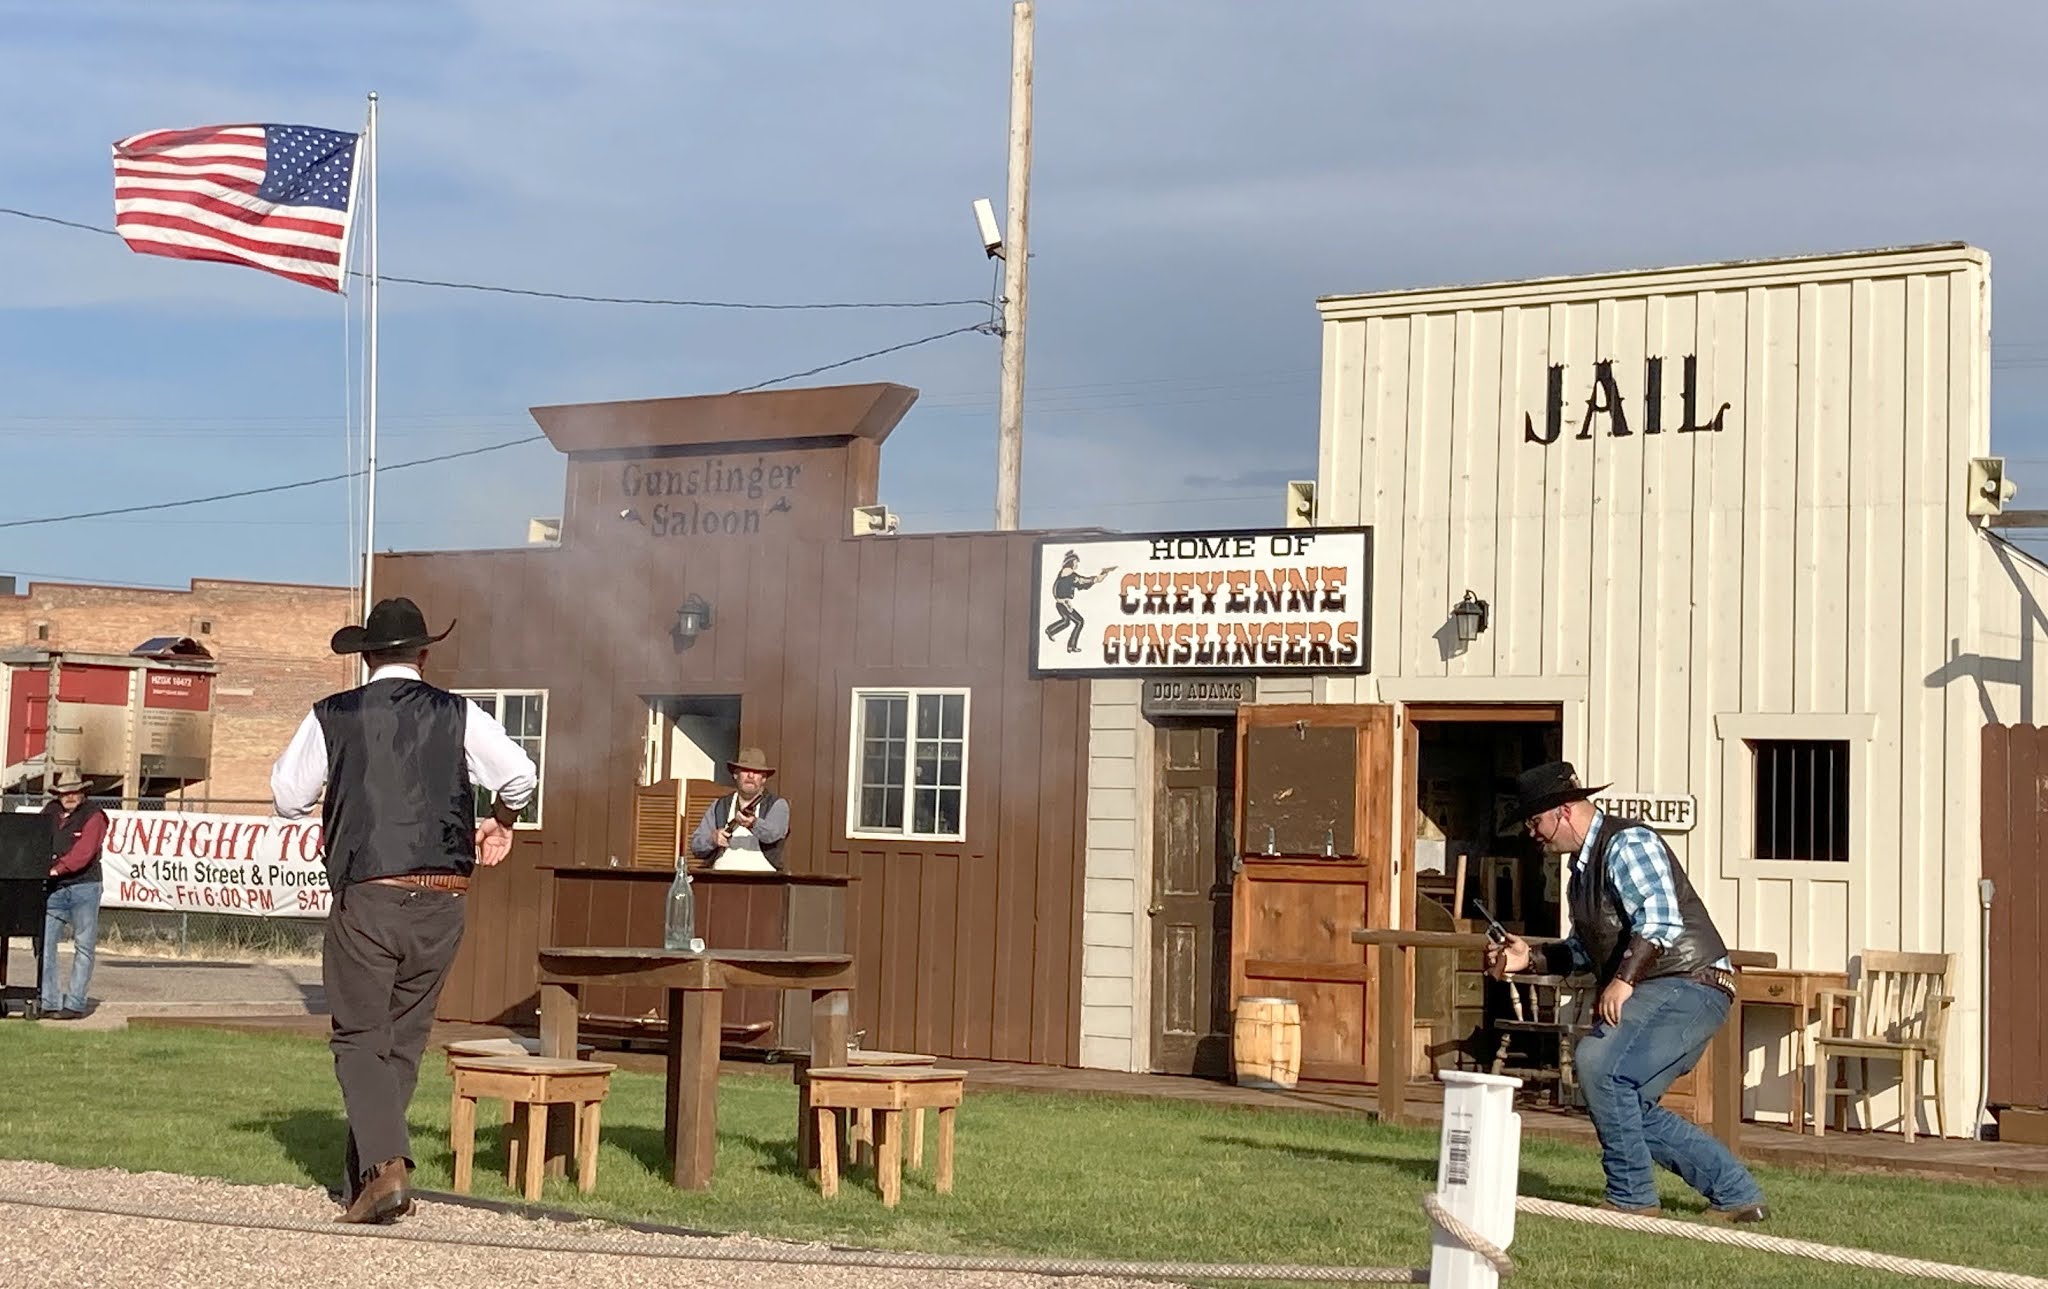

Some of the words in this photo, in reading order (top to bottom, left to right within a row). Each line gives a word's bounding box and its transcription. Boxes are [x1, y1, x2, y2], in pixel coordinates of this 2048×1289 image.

[1525, 353, 1731, 445] JAIL
[621, 457, 802, 499] Gunslinger
[651, 503, 760, 537] Saloon
[1149, 536, 1255, 560] HOME
[1270, 534, 1316, 557] OF
[1119, 566, 1347, 615] CHEYENNE
[1102, 621, 1358, 666] GUNSLINGERS
[1153, 682, 1182, 701] DOC
[1187, 682, 1243, 701] ADAMS
[130, 863, 147, 879] at
[153, 860, 188, 882] 15th
[194, 862, 246, 885] Street
[251, 864, 264, 884] &
[120, 881, 161, 902] Mon
[176, 885, 199, 905] Fri
[204, 887, 242, 909] 6:00
[247, 889, 275, 911] PM
[297, 889, 331, 911] SAT
